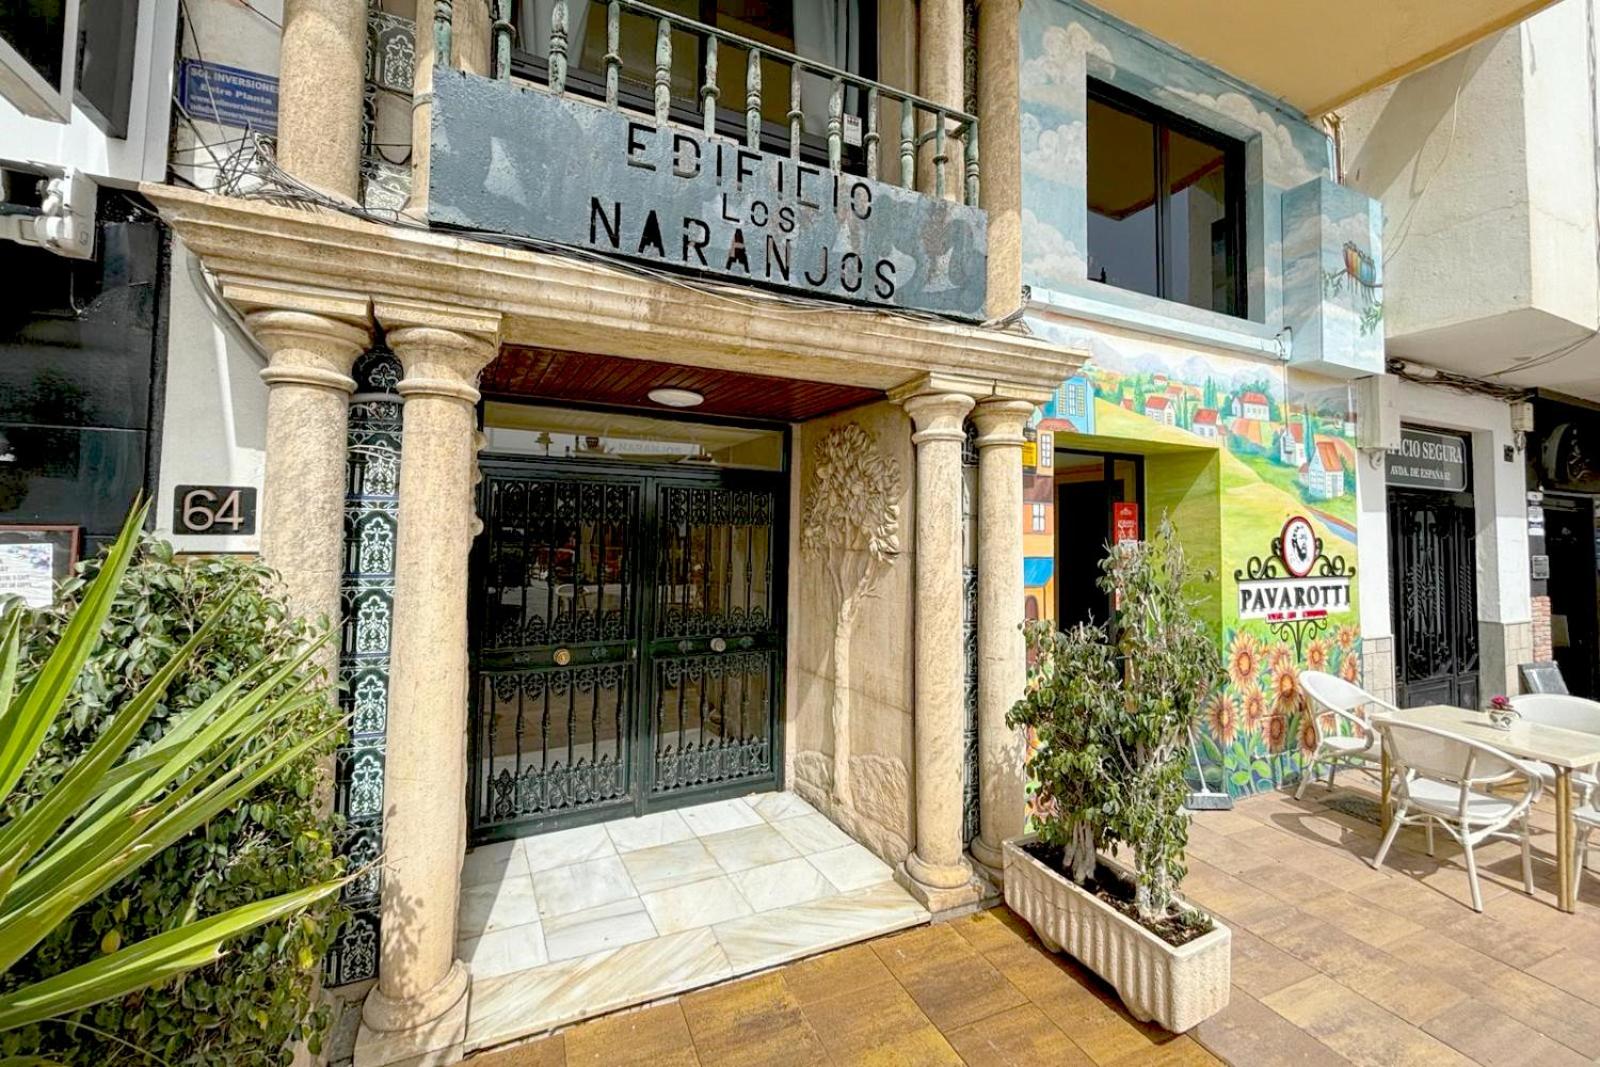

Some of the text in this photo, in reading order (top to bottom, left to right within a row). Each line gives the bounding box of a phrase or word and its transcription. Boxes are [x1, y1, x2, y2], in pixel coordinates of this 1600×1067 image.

[214, 72, 279, 93] INVERSIONE
[236, 90, 273, 105] Planta
[627, 122, 872, 220] EDIFICIO
[722, 192, 795, 233] LOS
[590, 196, 896, 300] NARANJOS
[1422, 441, 1463, 464] SEGURA
[183, 489, 244, 531] 64
[1240, 585, 1350, 612] PAVAROTTI
